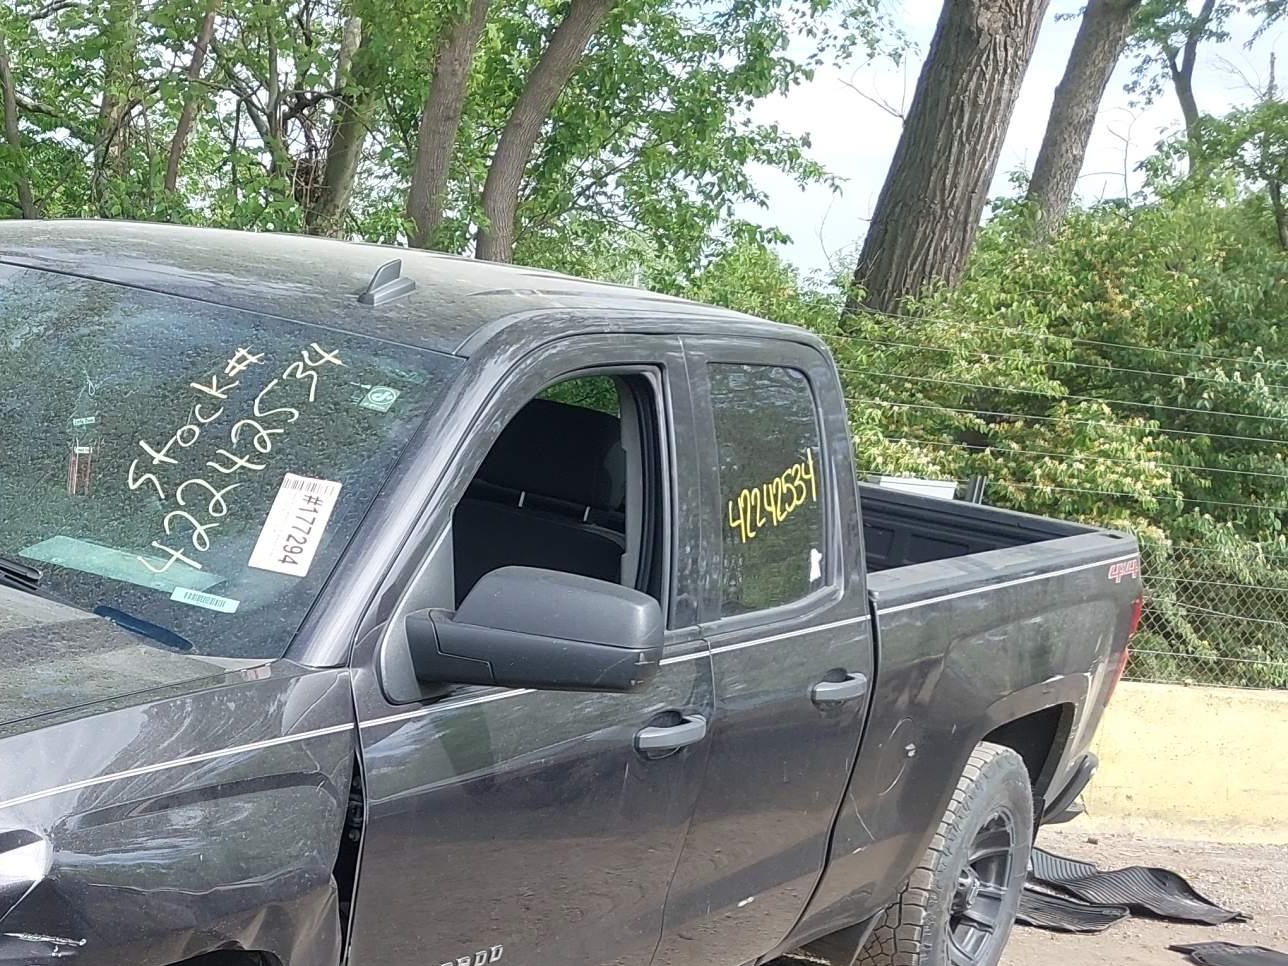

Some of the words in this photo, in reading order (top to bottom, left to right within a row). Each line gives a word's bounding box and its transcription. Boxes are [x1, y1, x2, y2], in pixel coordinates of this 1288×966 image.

[136, 342, 348, 573] 42242534
[728, 447, 817, 543] 42242534
[277, 494, 324, 565] #177294
